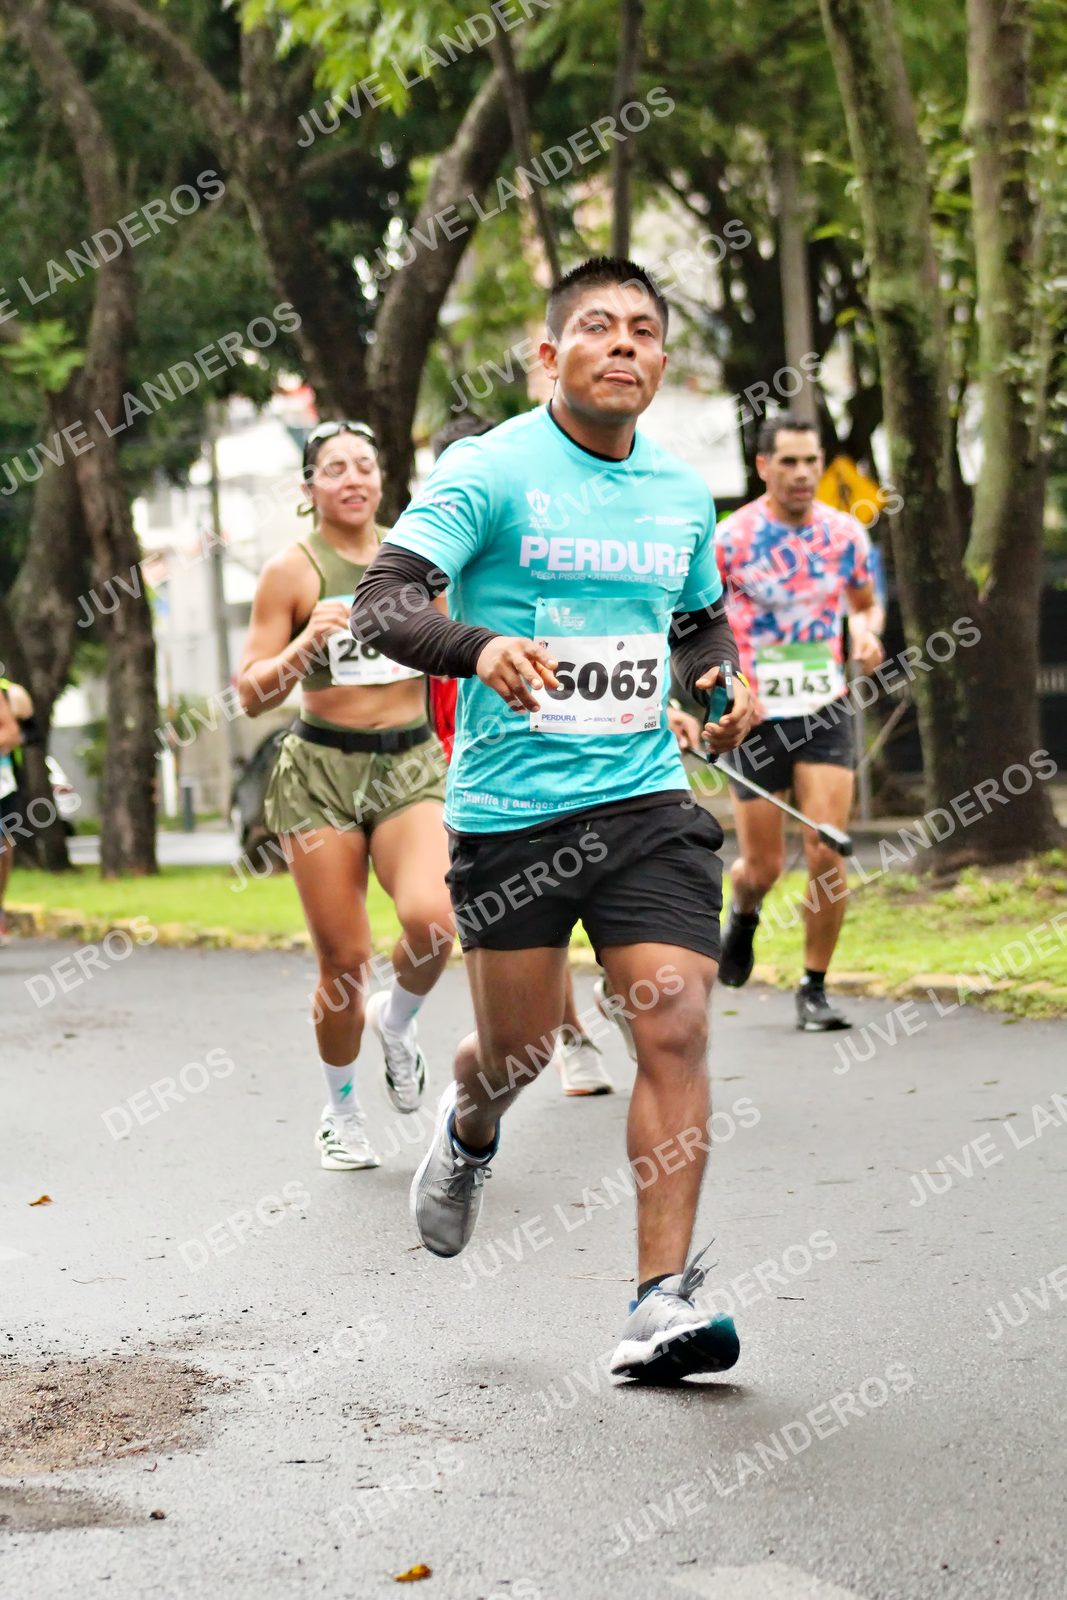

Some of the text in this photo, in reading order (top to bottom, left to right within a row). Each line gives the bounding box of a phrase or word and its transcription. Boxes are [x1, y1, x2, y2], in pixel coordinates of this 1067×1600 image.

[544, 658, 658, 701] 6063
[765, 674, 832, 697] 2143
[541, 713, 577, 722] PERDURA
[643, 720, 657, 729] 6063
